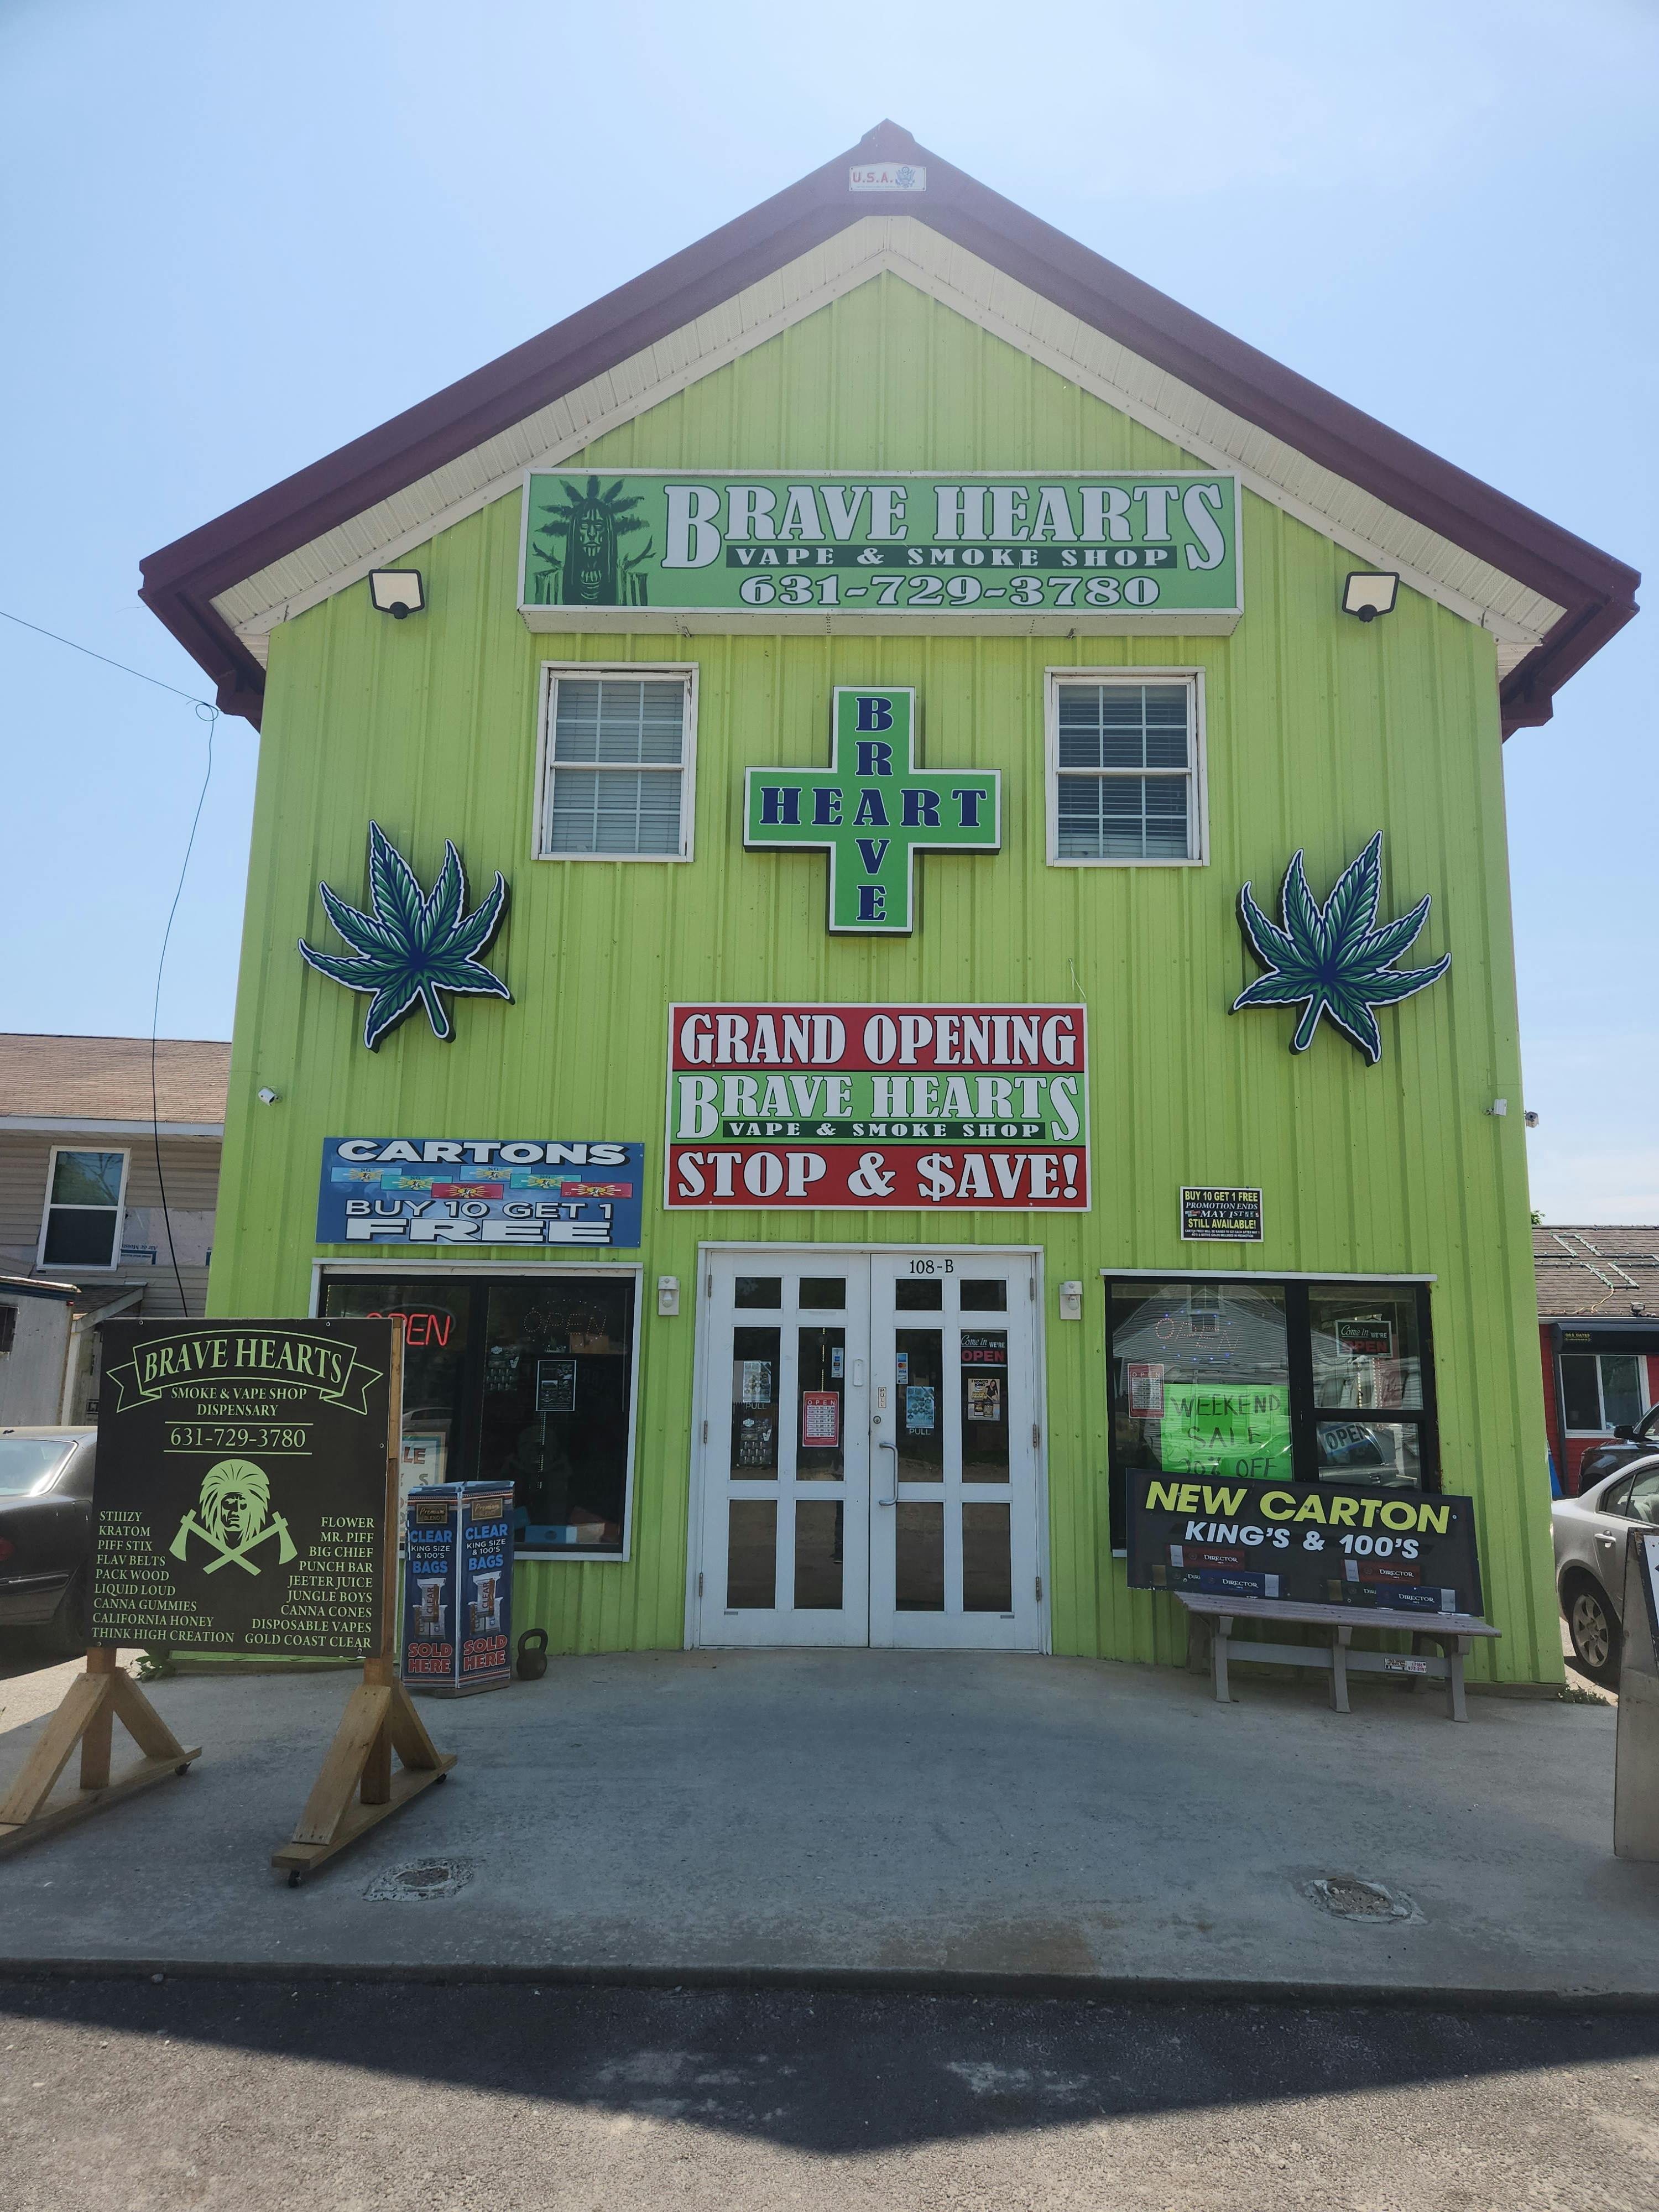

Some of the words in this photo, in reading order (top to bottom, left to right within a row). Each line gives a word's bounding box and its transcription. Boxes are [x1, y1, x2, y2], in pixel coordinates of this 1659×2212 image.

[853, 172, 894, 182] U.S.A.
[661, 483, 909, 570] BRAVE
[933, 483, 1226, 572] HEARTS
[735, 548, 834, 566] VAPE
[858, 549, 885, 565] &
[907, 549, 1039, 567] SMOKE
[1060, 549, 1170, 567] SHOP
[739, 575, 1162, 607] 631-729-3780
[759, 787, 987, 827] HEART
[852, 696, 894, 921] BRAVE
[680, 1014, 846, 1065] GRAND
[863, 1014, 1077, 1066] OPENING
[675, 1075, 853, 1139] BRAVE
[870, 1076, 1080, 1142] HEARTS
[729, 1123, 801, 1137] VAPE
[816, 1123, 836, 1137] &
[853, 1123, 947, 1137] SMOKE
[962, 1124, 1041, 1138] SHOP
[337, 1140, 631, 1166] CARTONS
[676, 1151, 827, 1198] STOP
[847, 1151, 896, 1198] &
[916, 1152, 1078, 1203] $AVE!
[1185, 1191, 1201, 1201] BUY
[1203, 1191, 1212, 1201] 10
[1214, 1192, 1229, 1201] GET
[1232, 1192, 1235, 1202] 1
[1238, 1192, 1258, 1202] FREE
[345, 1199, 435, 1217] BUY
[445, 1201, 489, 1218] 10
[502, 1202, 585, 1219] GET
[599, 1203, 612, 1219] 1
[345, 1218, 610, 1243] FREE
[1188, 1218, 1210, 1228] STILL
[1212, 1219, 1256, 1229] AVAILABLE!
[909, 1259, 954, 1274] 108-B
[1341, 1324, 1360, 1336] Come
[961, 1334, 979, 1345] Come
[143, 1338, 228, 1383] BRAVE
[234, 1338, 342, 1384] HEARTS
[961, 1350, 1005, 1362] OPEN
[171, 1387, 217, 1399] SMOKE
[220, 1387, 229, 1400] &
[232, 1387, 267, 1400] VAPE
[269, 1387, 307, 1400] SHOP
[196, 1404, 279, 1416] DISPENSARY
[1170, 1394, 1281, 1417] WEEKEND
[170, 1427, 306, 1448] 631-729-3780
[1187, 1426, 1265, 1449] SALE
[1326, 1423, 1371, 1450] OPEN
[1236, 1457, 1277, 1478] OFF
[1145, 1481, 1248, 1516] NEW
[1259, 1491, 1450, 1534] CARTON
[100, 1511, 143, 1522] STIIIZY
[321, 1516, 375, 1528] FLOWER
[98, 1525, 151, 1537] KRATOM
[320, 1532, 343, 1543] MR.
[346, 1532, 374, 1543] PIFF
[410, 1530, 452, 1543] CLEAR
[465, 1524, 508, 1540] CLEAR
[97, 1540, 123, 1550] PIFF
[126, 1541, 153, 1551] STIX
[489, 1538, 506, 1547] SIZE
[1184, 1521, 1291, 1548] KING'S
[1302, 1531, 1324, 1551] &
[1339, 1534, 1420, 1559] 100'S
[309, 1546, 331, 1557] BIG
[334, 1547, 373, 1558] CHIEF
[1203, 1554, 1239, 1563] DIRECTOR
[96, 1554, 127, 1565] FLAV
[129, 1555, 166, 1566] BELTS
[299, 1561, 345, 1572] PUNCH
[348, 1562, 373, 1573] BAR
[413, 1561, 448, 1574] BAGS
[468, 1554, 504, 1571] BAGS
[95, 1569, 128, 1579] PACK
[131, 1570, 169, 1581] WOOD
[1379, 1569, 1415, 1577] DIRECTOR
[95, 1583, 138, 1597] LIQUID
[140, 1585, 176, 1596] LOUD
[287, 1575, 334, 1588] JEETER
[335, 1577, 373, 1590] JUICE
[1222, 1579, 1259, 1588] DIRECTOR
[286, 1590, 337, 1603] JUNGLE
[339, 1592, 373, 1603] BOYS
[1399, 1593, 1434, 1603] DIRECTOR
[93, 1598, 136, 1610] CANNA
[139, 1599, 197, 1611] GUMMIES
[280, 1604, 326, 1616] CANNA
[328, 1606, 372, 1618] CONES
[92, 1613, 167, 1625] CALIFORNIA
[170, 1615, 215, 1627] HONEY
[252, 1618, 328, 1631] DISPOSABLE
[332, 1621, 372, 1633] VAPES
[92, 1627, 133, 1639] THINK
[134, 1629, 166, 1640] HIGH
[169, 1630, 234, 1643] CREATION
[245, 1633, 281, 1645] GOLD
[284, 1635, 327, 1647] COAST
[329, 1636, 372, 1648] CLEAR
[408, 1642, 453, 1657] SOLD
[464, 1635, 508, 1655] SOLD
[408, 1658, 451, 1673] HERE
[464, 1650, 505, 1671] HERE
